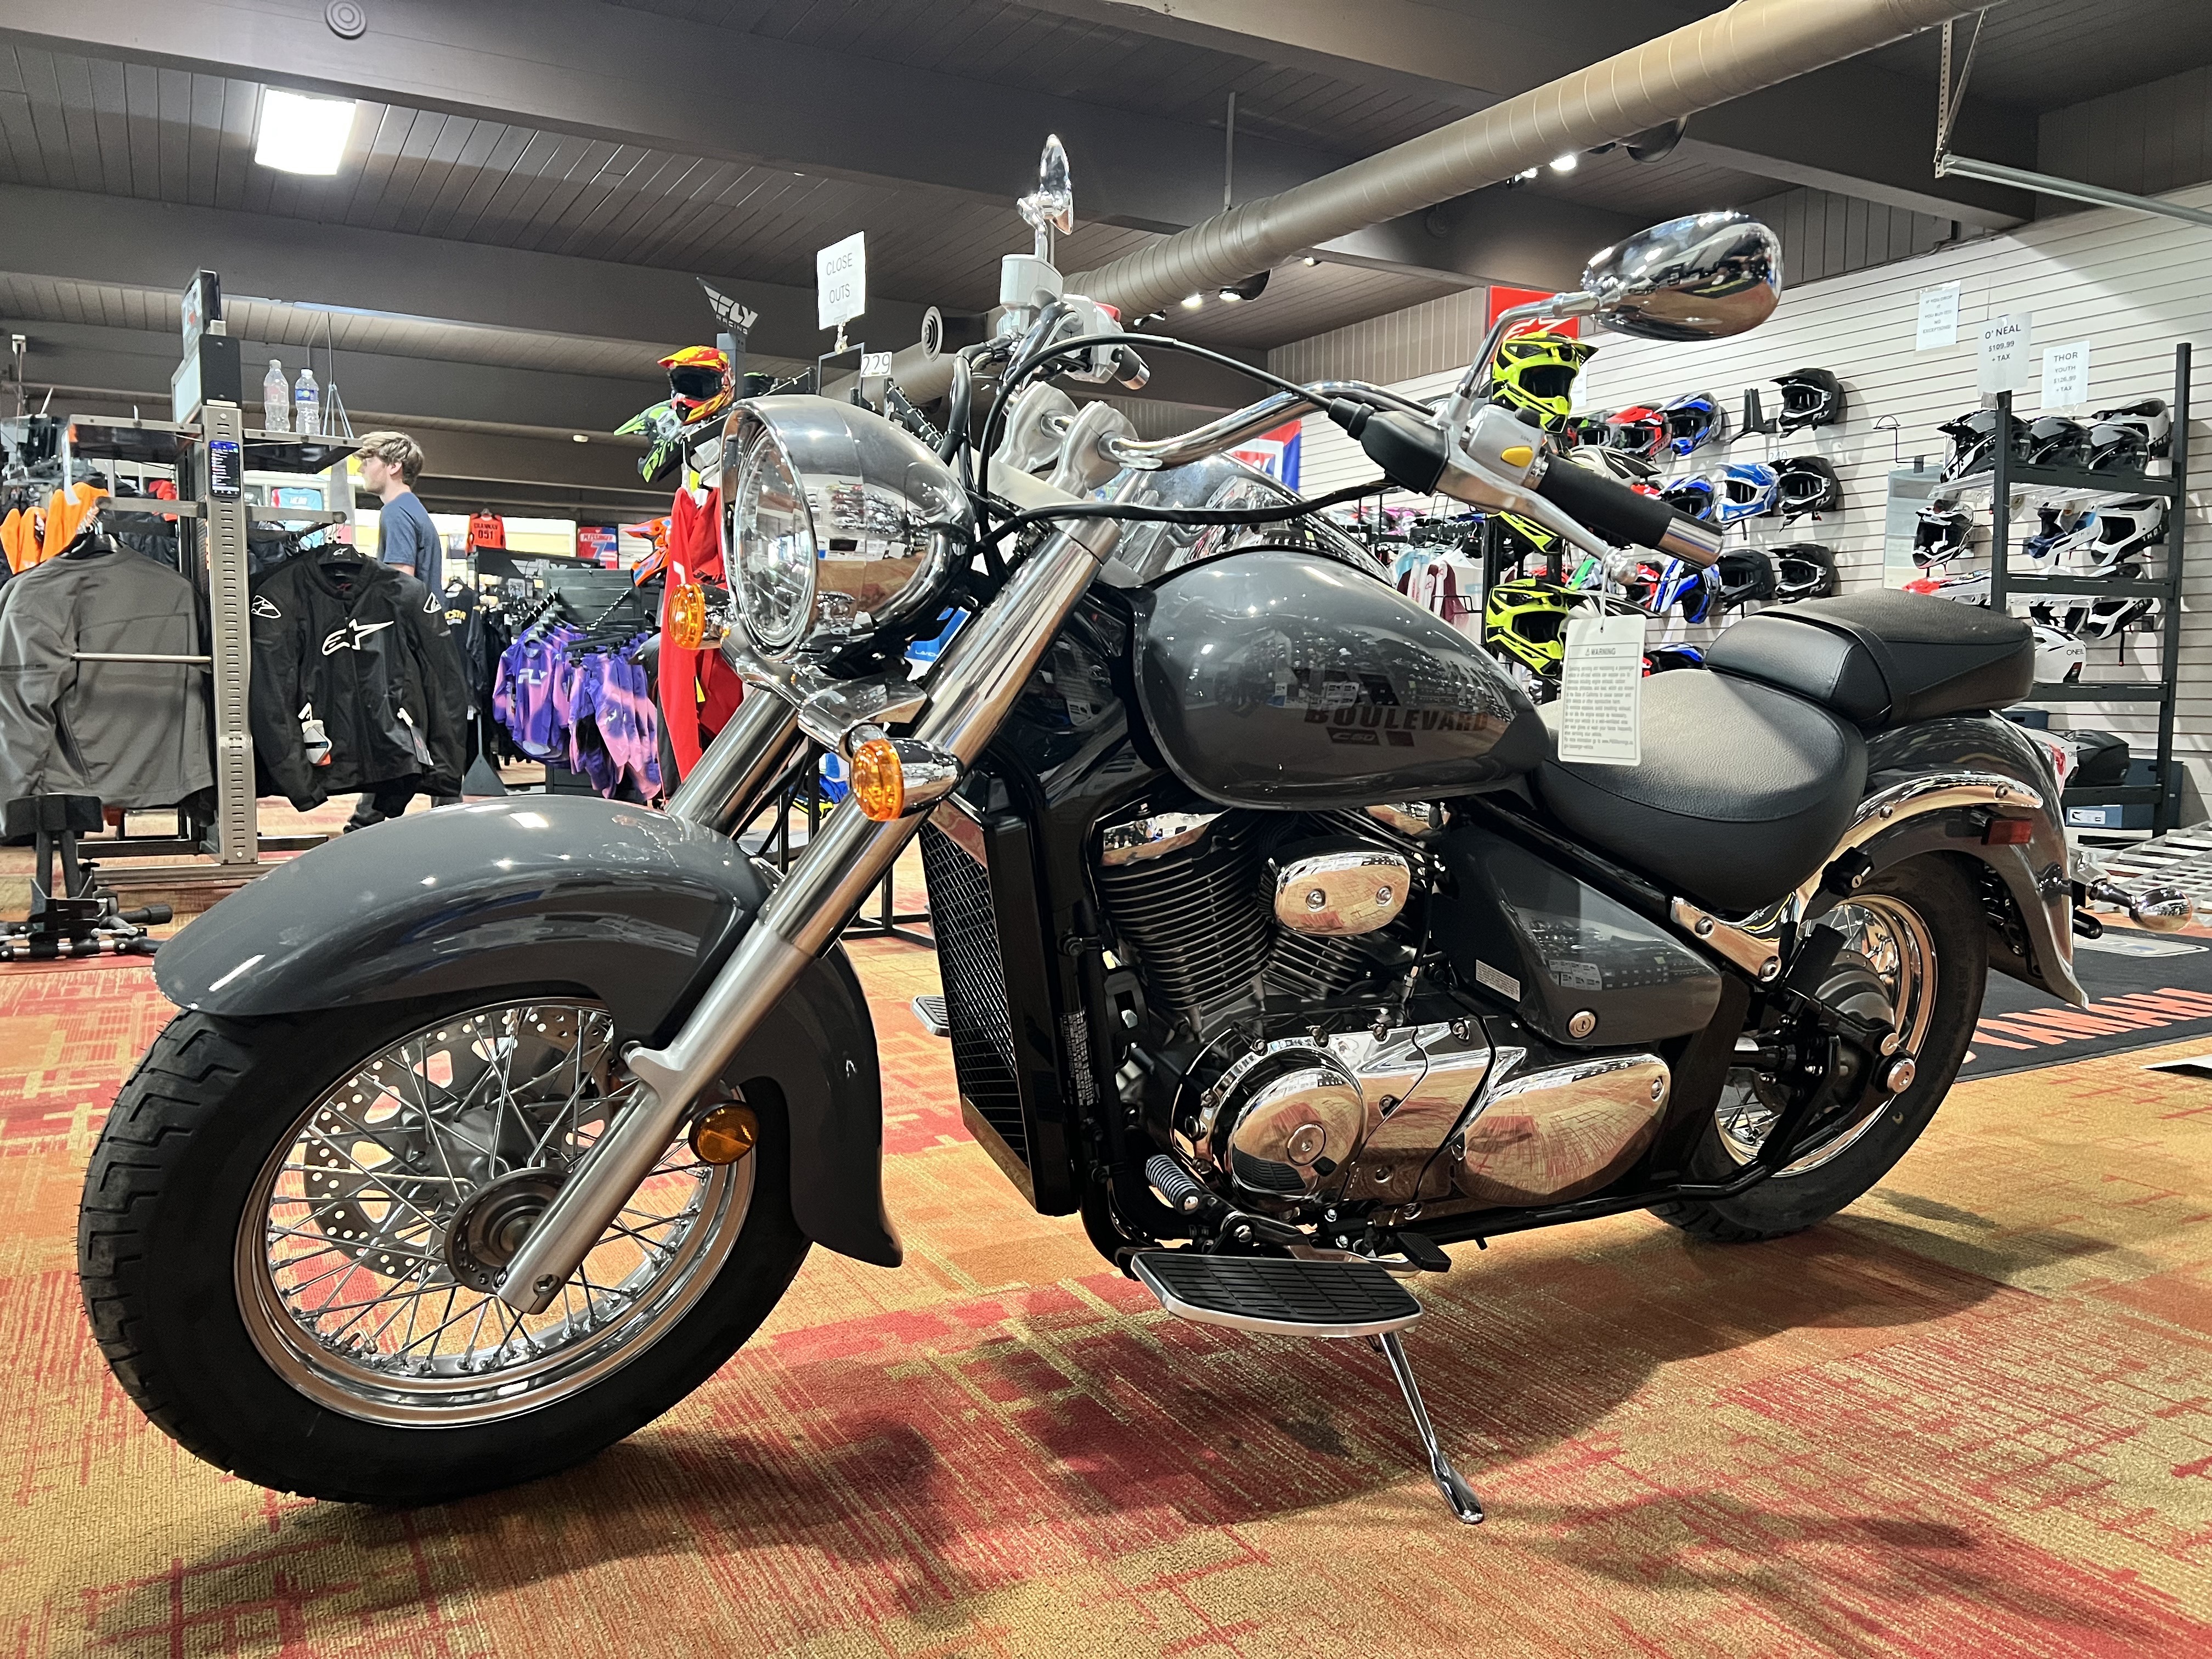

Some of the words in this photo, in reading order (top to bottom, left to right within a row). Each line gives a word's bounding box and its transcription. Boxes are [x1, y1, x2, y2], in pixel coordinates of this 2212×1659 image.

[826, 252, 853, 276] CLOSE
[829, 283, 851, 304] OUTS
[708, 288, 758, 328] FLY
[715, 314, 748, 335] RACING
[1995, 324, 2022, 337] NEAL
[1988, 340, 2015, 352] $109.99
[1997, 353, 2011, 362] TAX
[2053, 352, 2078, 362] THOR
[2055, 365, 2076, 374] YOUTH
[1812, 409, 1830, 421] FLY
[1815, 494, 1831, 508] FLY
[1809, 582, 1826, 595] FLY
[1590, 647, 1616, 656] WARNING
[517, 668, 548, 685] FLY
[1304, 706, 1489, 732] BOULEVARD
